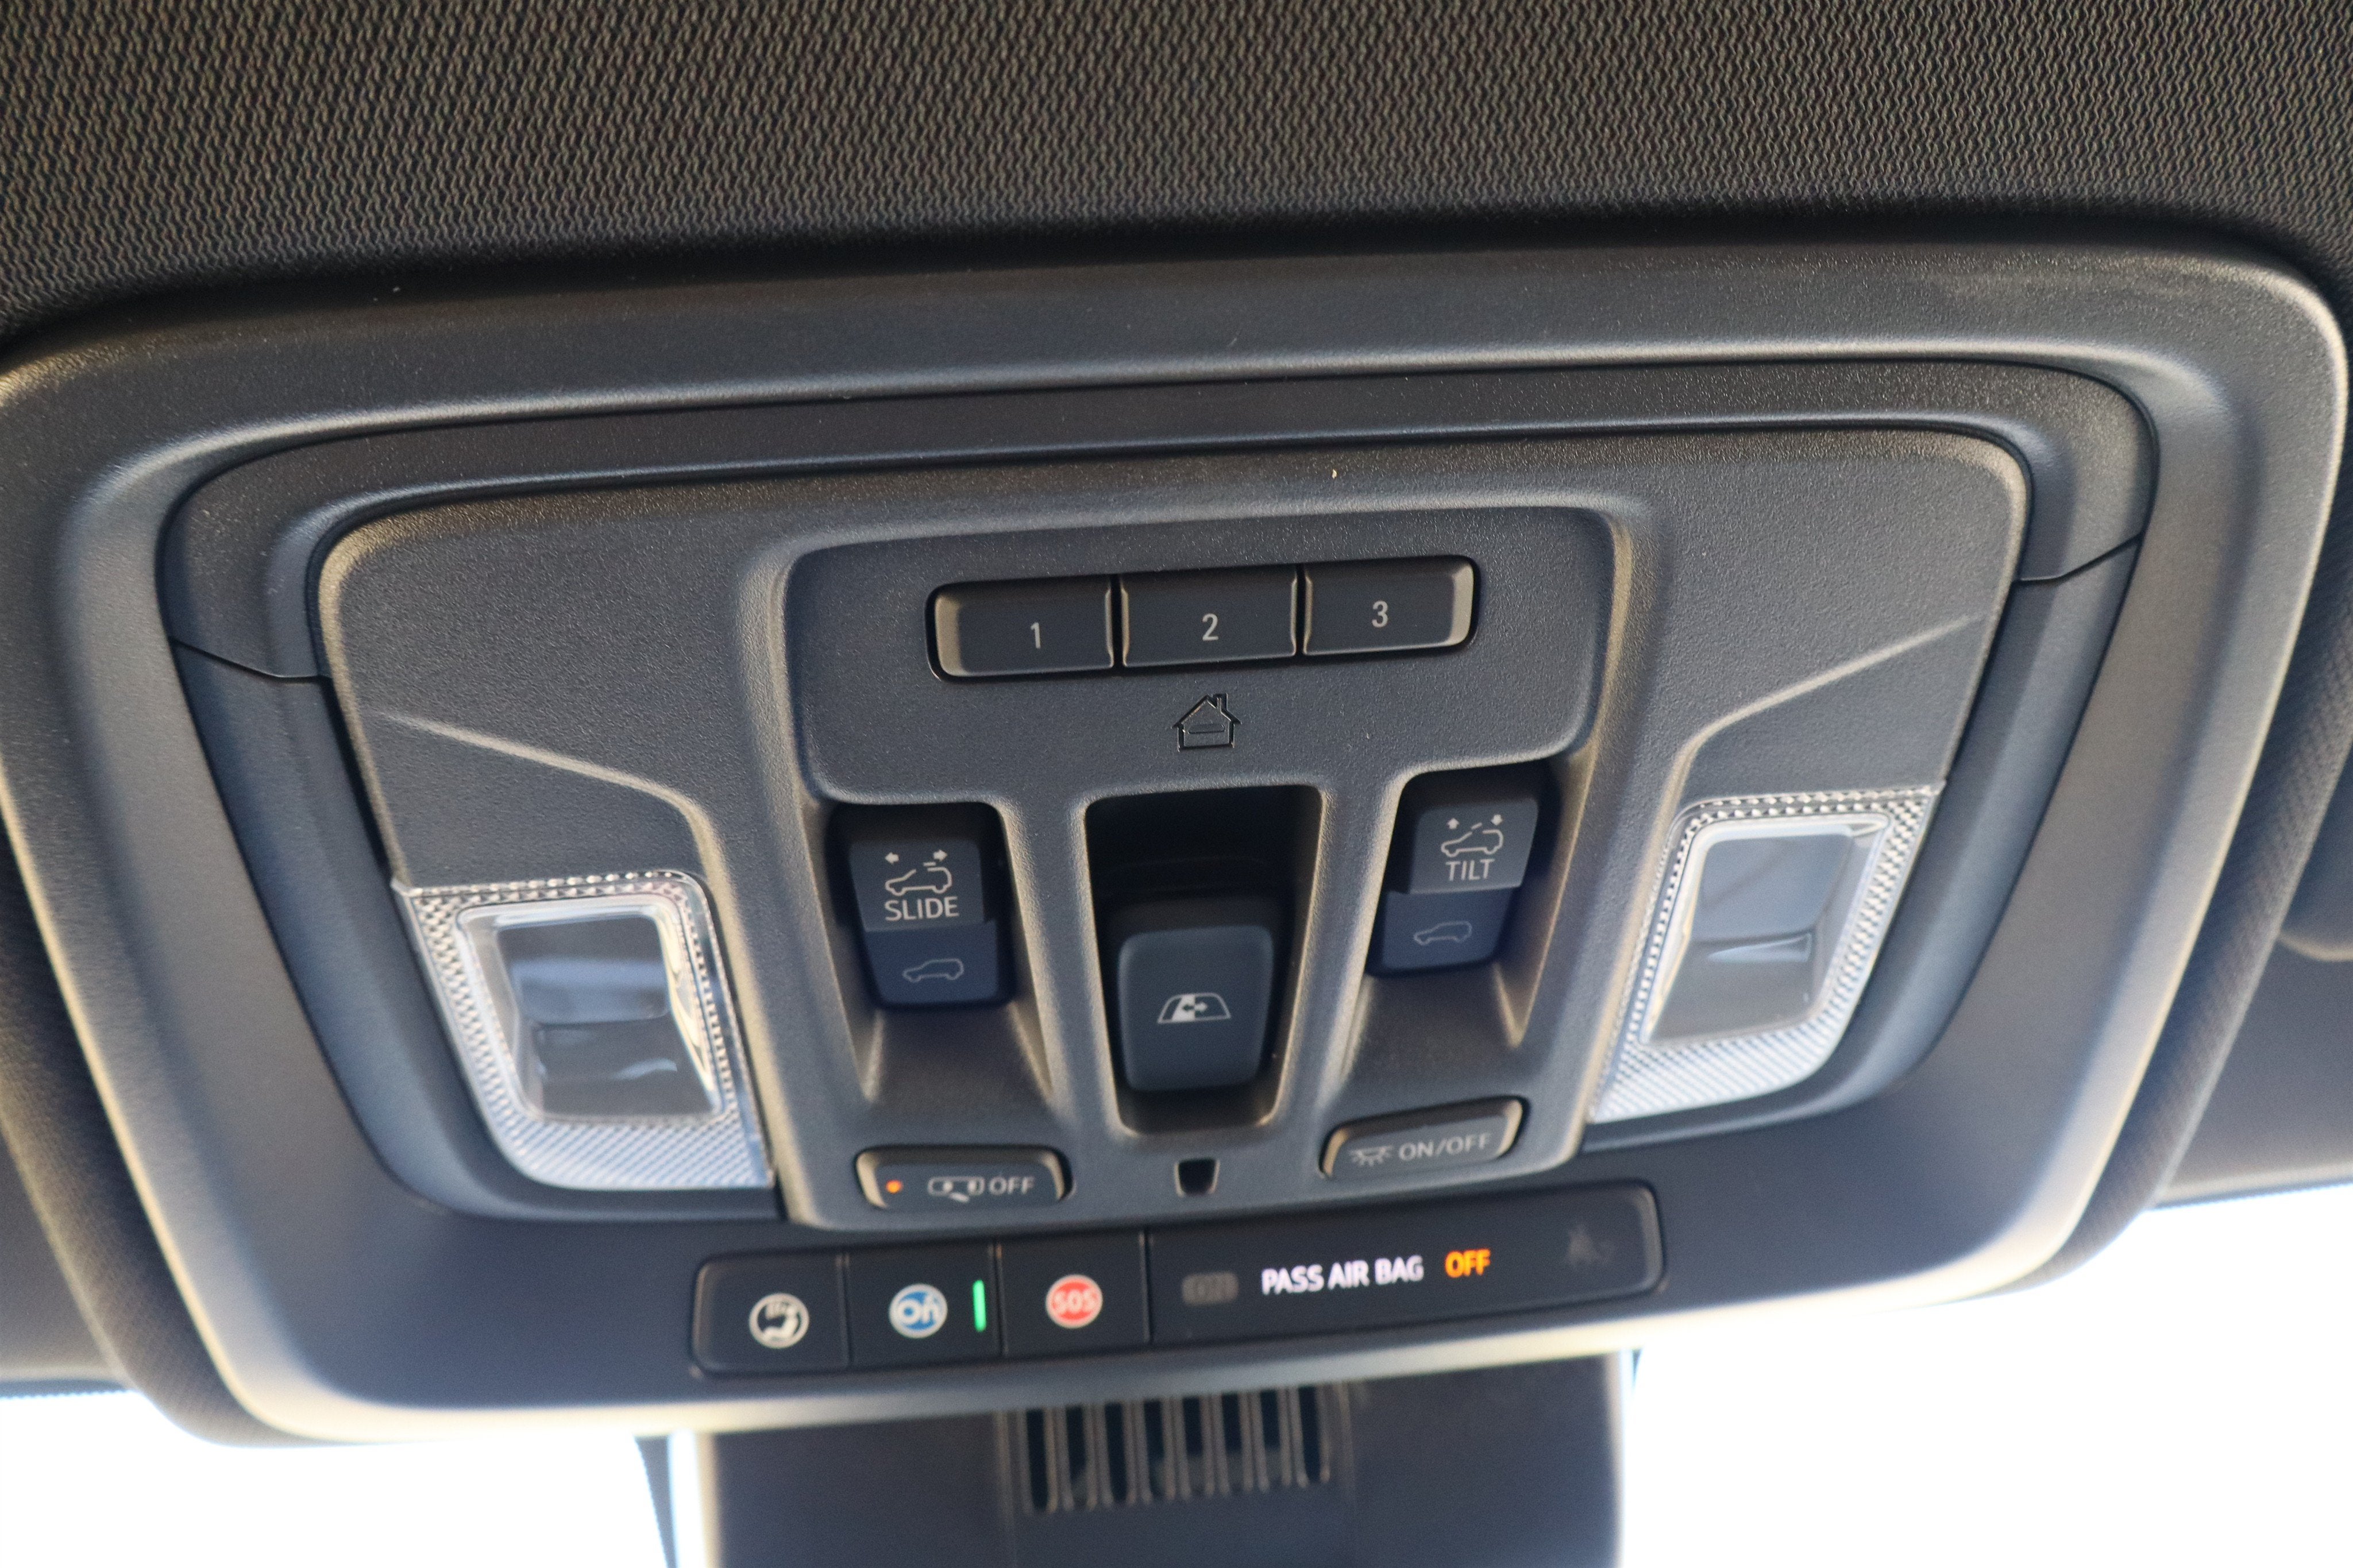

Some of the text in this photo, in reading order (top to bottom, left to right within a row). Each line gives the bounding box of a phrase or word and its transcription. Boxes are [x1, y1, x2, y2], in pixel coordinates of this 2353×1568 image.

[1201, 613, 1220, 642] 2
[1371, 601, 1388, 628] 3
[1030, 622, 1041, 649] 1
[1445, 859, 1495, 882] TILT
[885, 896, 960, 921] SLIDE
[1398, 1132, 1492, 1161] ON/OFF
[989, 1176, 1035, 1196] OFF
[1262, 1248, 1491, 1296] PASS AIR BAG OFF
[1052, 1288, 1098, 1313] SOS
